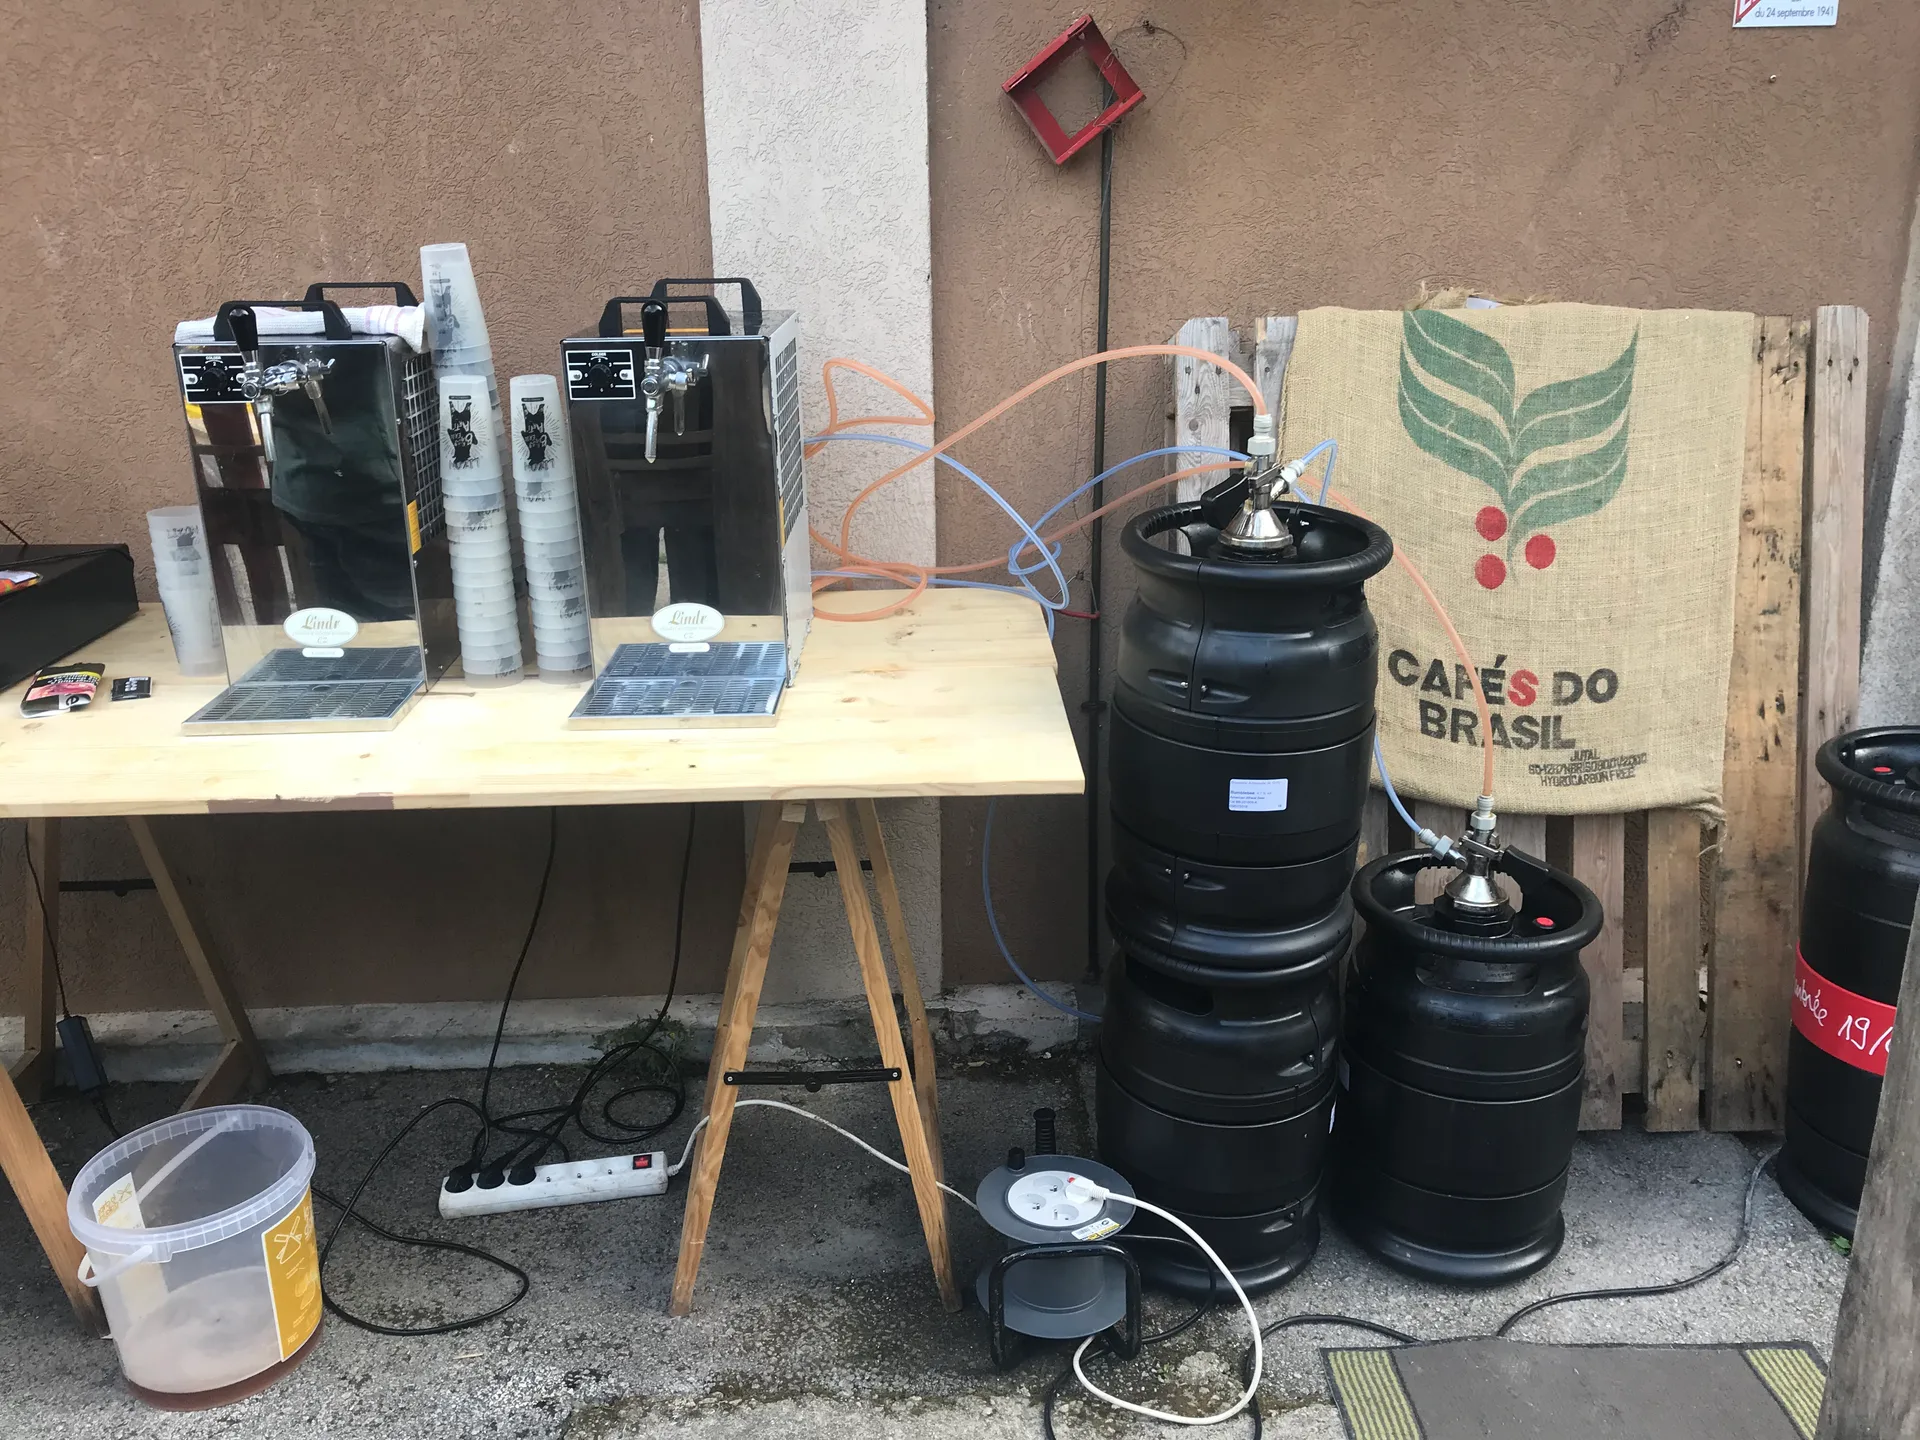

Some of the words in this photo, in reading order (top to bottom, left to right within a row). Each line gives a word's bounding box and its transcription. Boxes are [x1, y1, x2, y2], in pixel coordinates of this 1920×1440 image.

[1755, 8, 1764, 18] du
[1766, 8, 1776, 18] 24
[1776, 7, 1815, 20] septembre
[1817, 6, 1834, 17] 1941
[301, 614, 341, 630] Lindr
[668, 610, 707, 625] Lindr
[1388, 649, 1540, 707] CAFÉS
[1552, 668, 1618, 707] DO
[1418, 700, 1576, 750] BRASIL
[1540, 771, 1609, 786] HYDROCARBON
[1610, 766, 1636, 781] FREE
